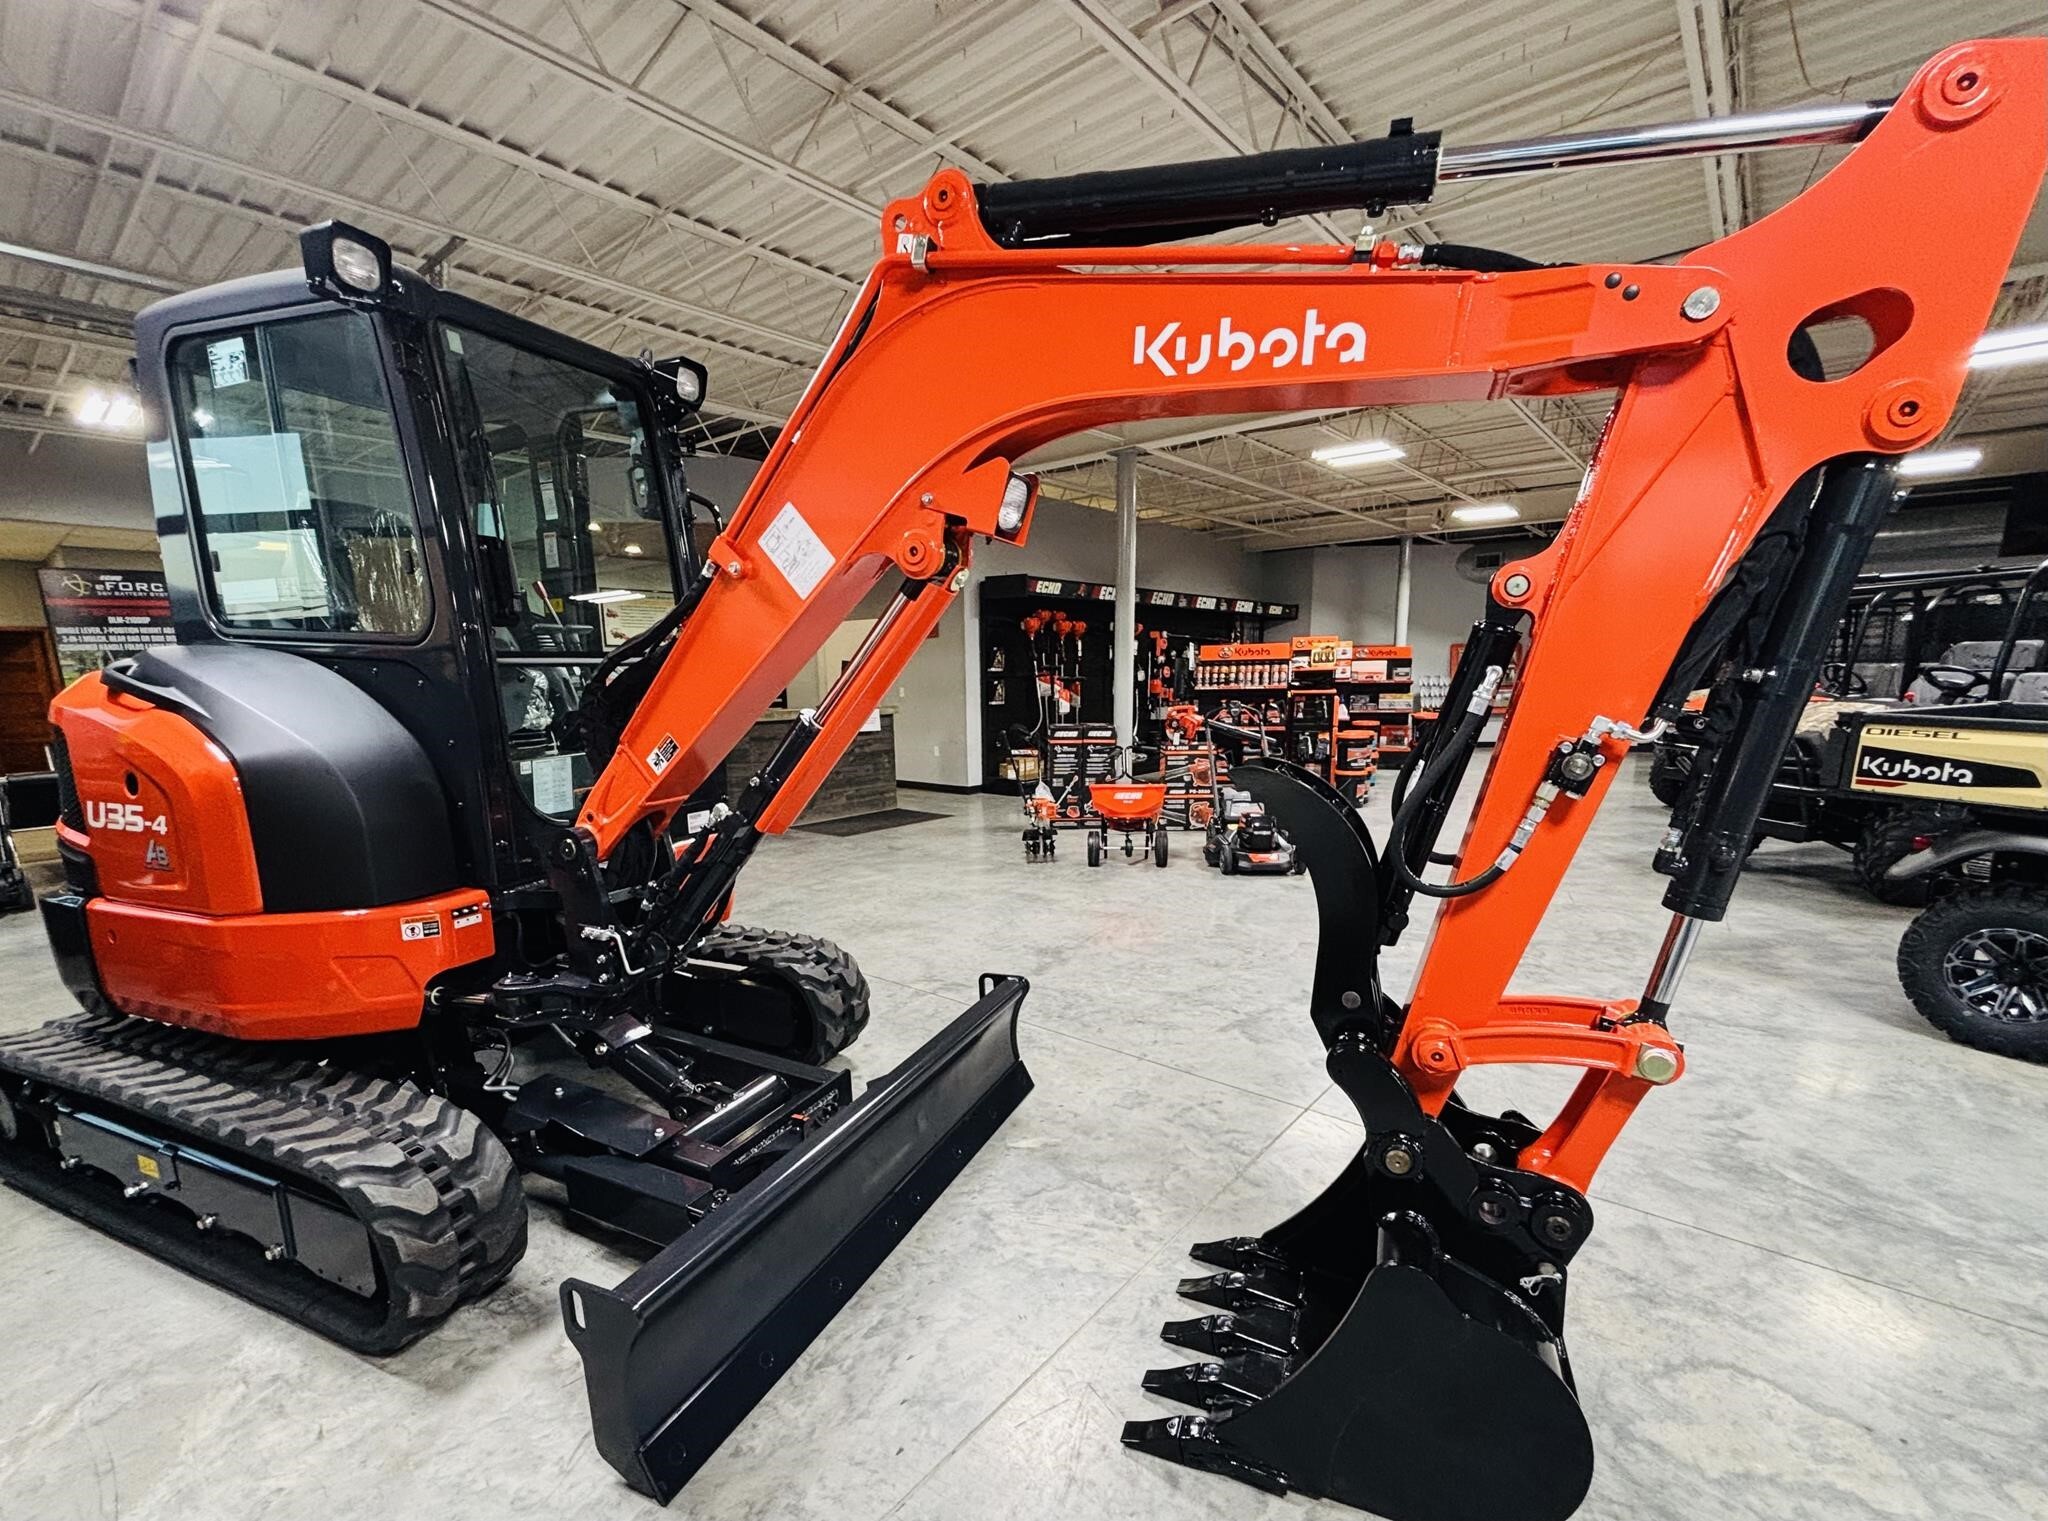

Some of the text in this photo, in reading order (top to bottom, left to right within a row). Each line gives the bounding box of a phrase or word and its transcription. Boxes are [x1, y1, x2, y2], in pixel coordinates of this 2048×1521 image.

[1133, 309, 1367, 377] Kubota
[1036, 580, 1062, 595] ECHO
[1151, 591, 1175, 606] ECHO
[1196, 596, 1216, 610] ECHO
[1235, 600, 1254, 613] ECHO
[1235, 645, 1271, 657] Kubota
[1866, 727, 1971, 740] DIESEL
[1862, 756, 1974, 784] Kubota
[86, 800, 168, 835] U35-4
